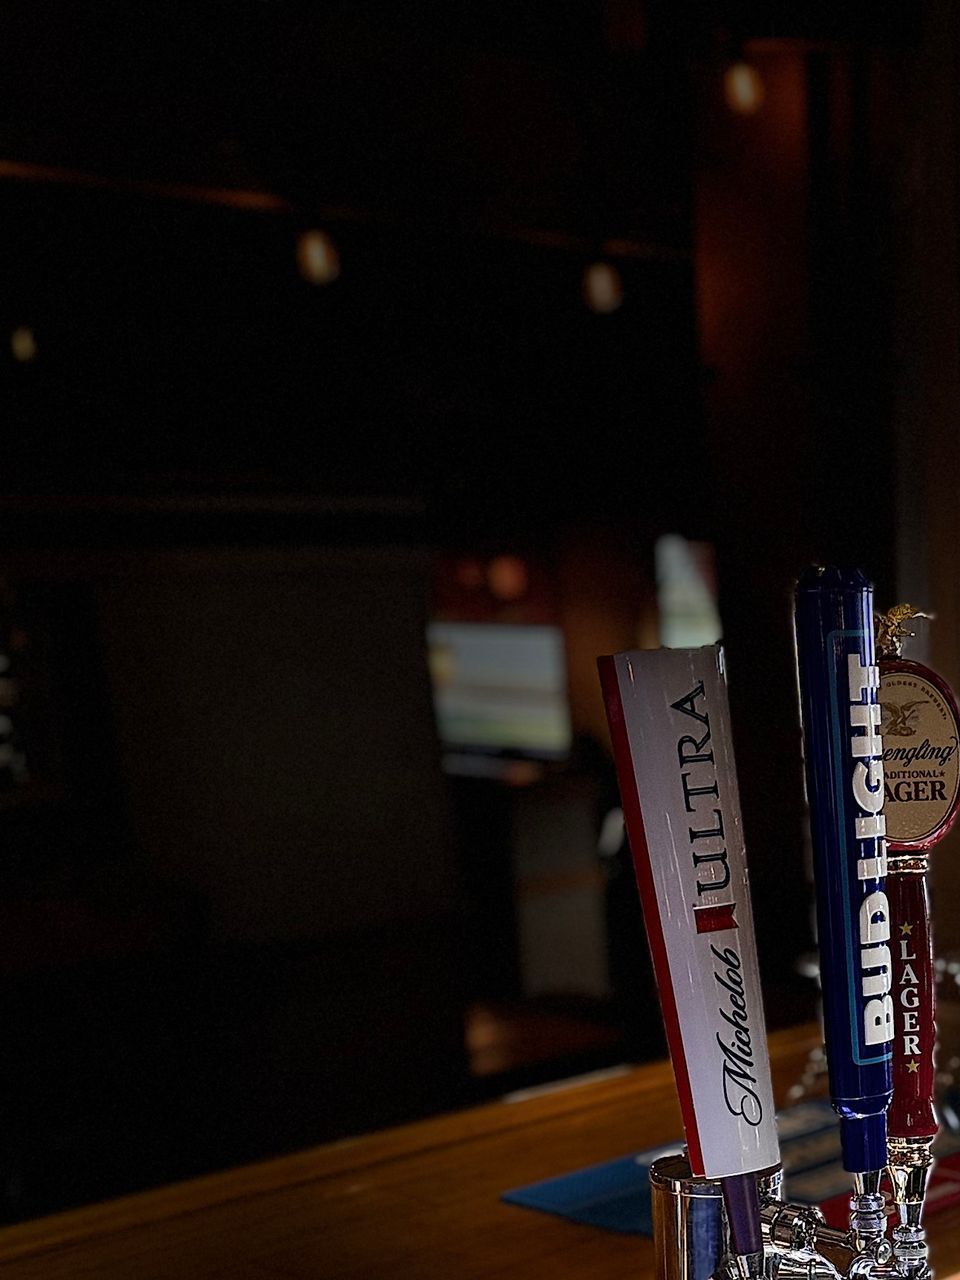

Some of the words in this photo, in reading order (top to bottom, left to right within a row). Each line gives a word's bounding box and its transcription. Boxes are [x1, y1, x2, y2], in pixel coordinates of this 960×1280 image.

[670, 679, 731, 898] ULTRA
[847, 653, 888, 881] LIGHT
[884, 769, 939, 780] ADITIONAL
[884, 780, 947, 802] AGER
[709, 943, 763, 1127] Michelob
[859, 891, 895, 1046] BUD
[899, 939, 922, 1056] LAGER
